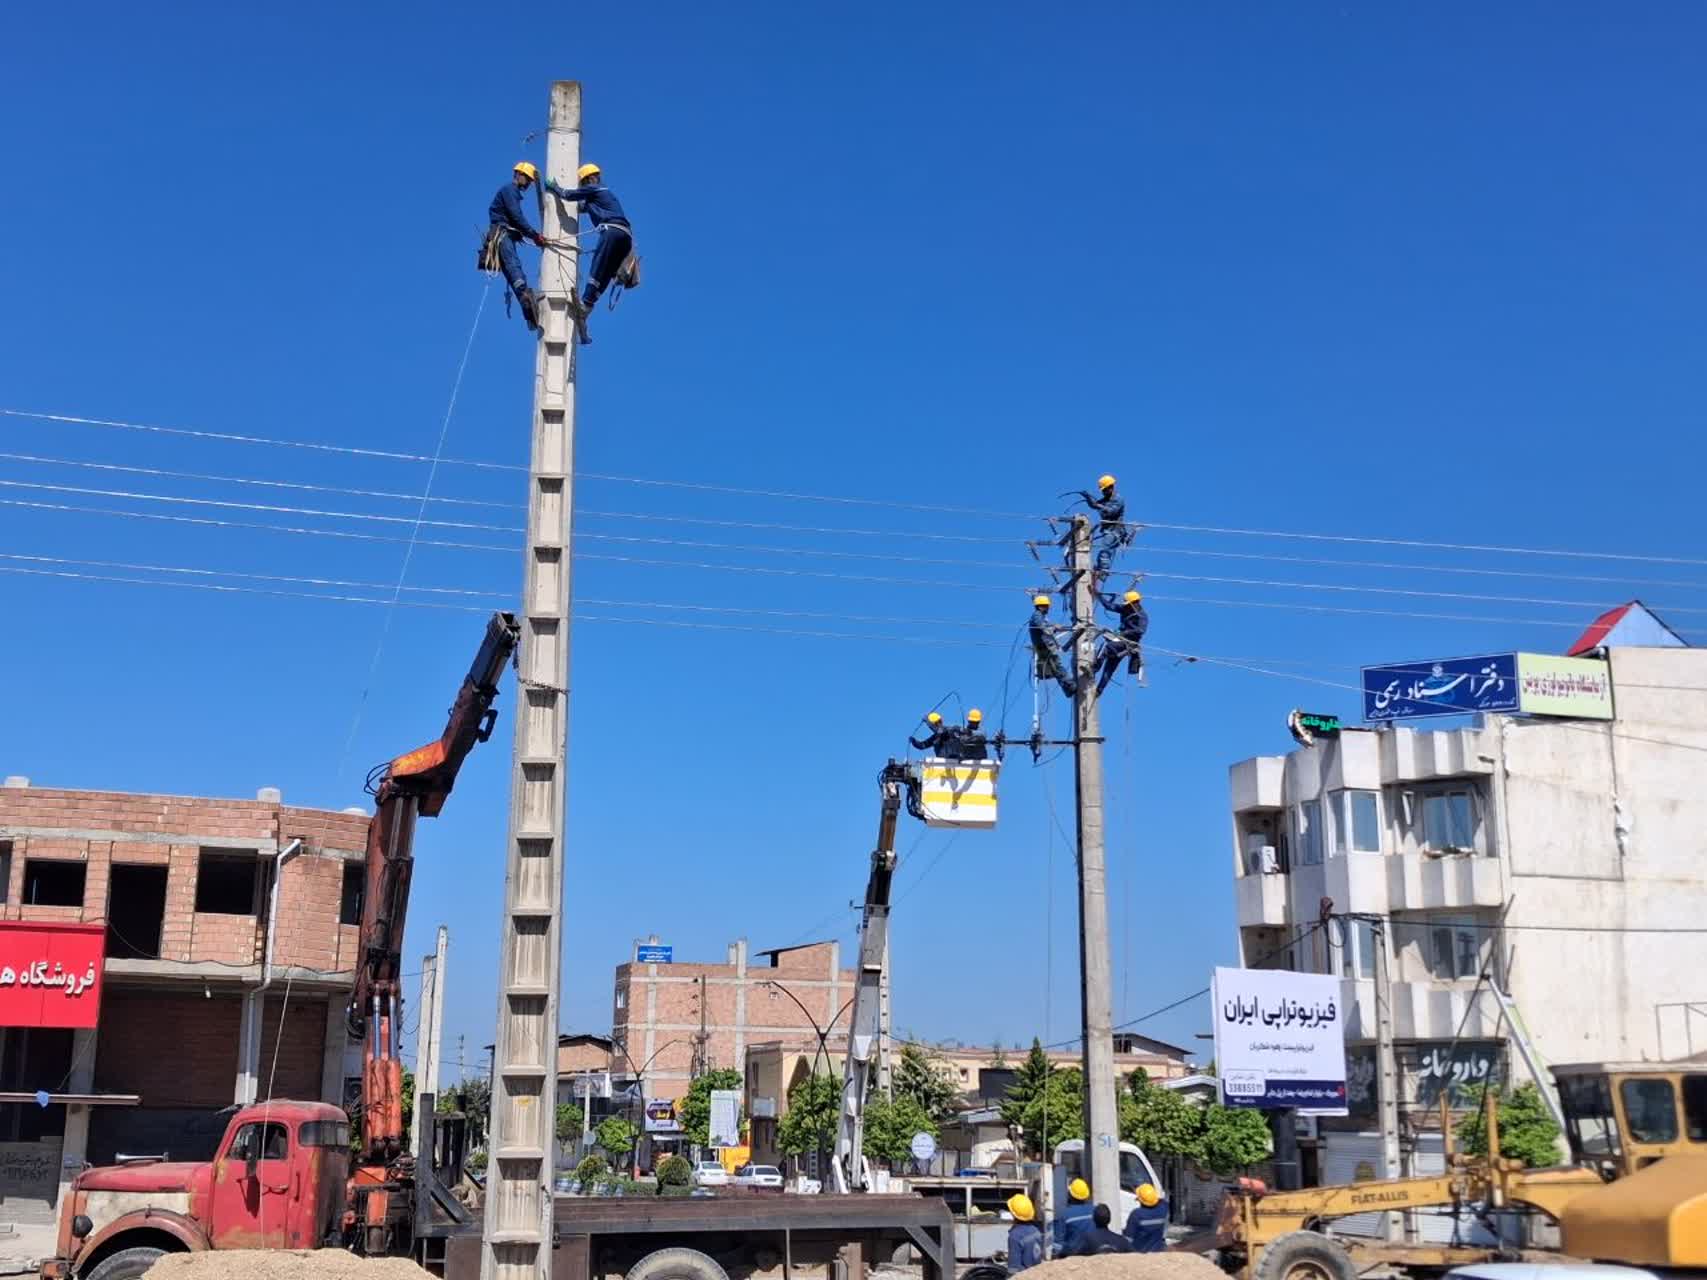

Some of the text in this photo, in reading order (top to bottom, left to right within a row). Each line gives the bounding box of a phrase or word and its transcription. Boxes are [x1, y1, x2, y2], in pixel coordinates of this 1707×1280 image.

[1474, 663, 1504, 698] دفتر
[20, 961, 95, 995] فروشگاه
[1224, 995, 1336, 1030] فیزیوتراپی ایران
